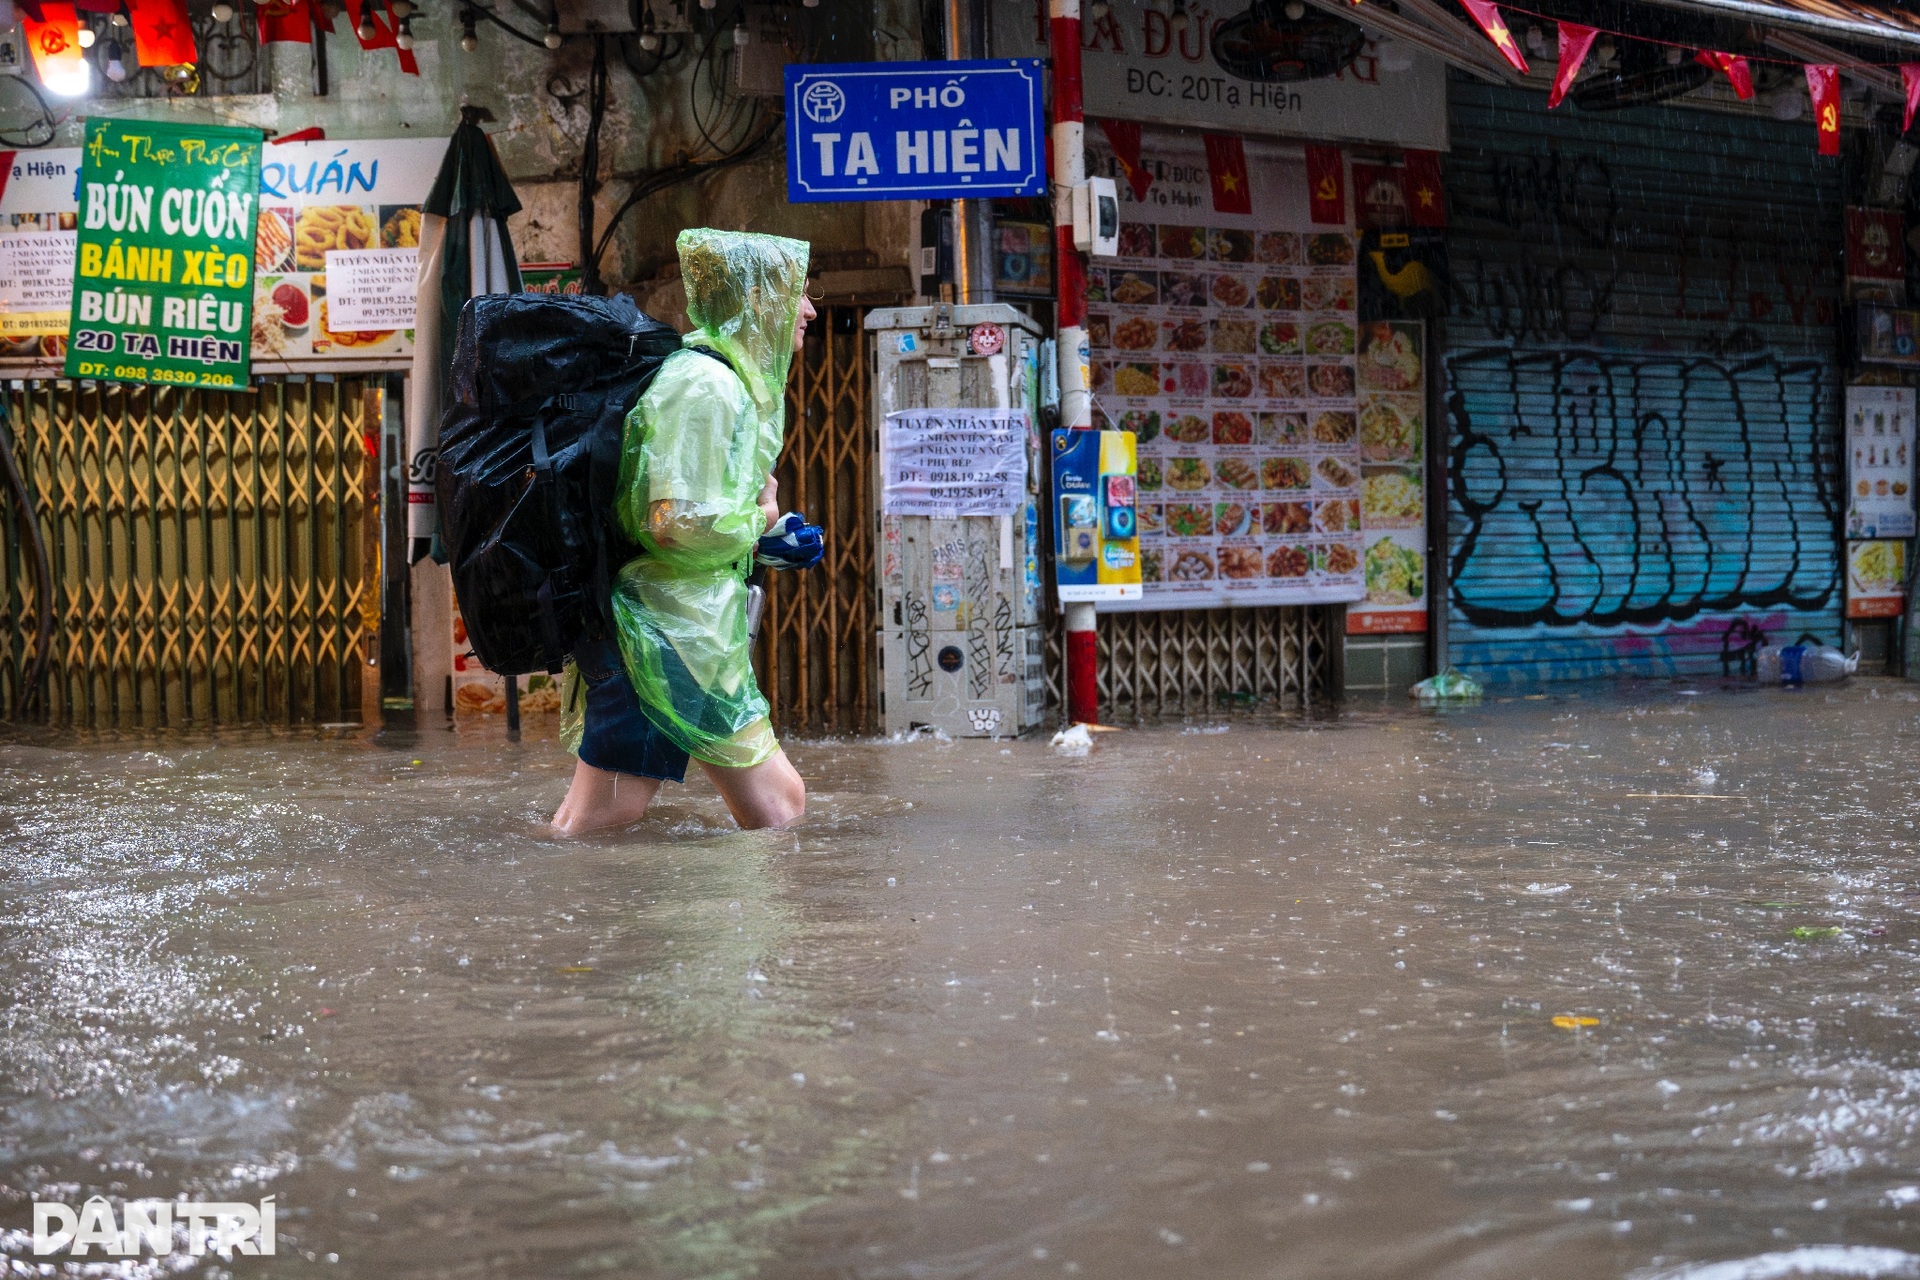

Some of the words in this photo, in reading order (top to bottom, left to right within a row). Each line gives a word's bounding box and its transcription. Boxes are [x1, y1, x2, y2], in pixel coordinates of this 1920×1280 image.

[890, 76, 968, 110] PHỐ
[1127, 67, 1172, 97] ĐC:
[1250, 83, 1301, 114] Hiện
[812, 131, 880, 185] TẠ
[896, 118, 1021, 183] HIỆN
[27, 161, 66, 180] Hiện
[259, 149, 378, 199] QUÁN
[84, 169, 154, 234] BÚN
[160, 168, 253, 240] CUỐN
[80, 238, 173, 284] BÁNH
[180, 244, 248, 289] XÈO
[406, 255, 416, 264] VI
[22, 279, 73, 287] 0918.19.22.5
[22, 290, 72, 299] 09.1975.197
[79, 287, 152, 326] BÚN
[163, 293, 243, 333] RIÊU
[76, 330, 115, 353] 20
[123, 333, 160, 359] TẠ
[168, 336, 242, 364] HIỆN
[79, 362, 109, 377] ĐT:
[114, 365, 147, 380] 098
[152, 369, 196, 384] 3630
[201, 372, 234, 387] 206
[947, 416, 988, 430] NHÂN
[991, 416, 1023, 430] VIÊN
[900, 471, 922, 482] ĐT:
